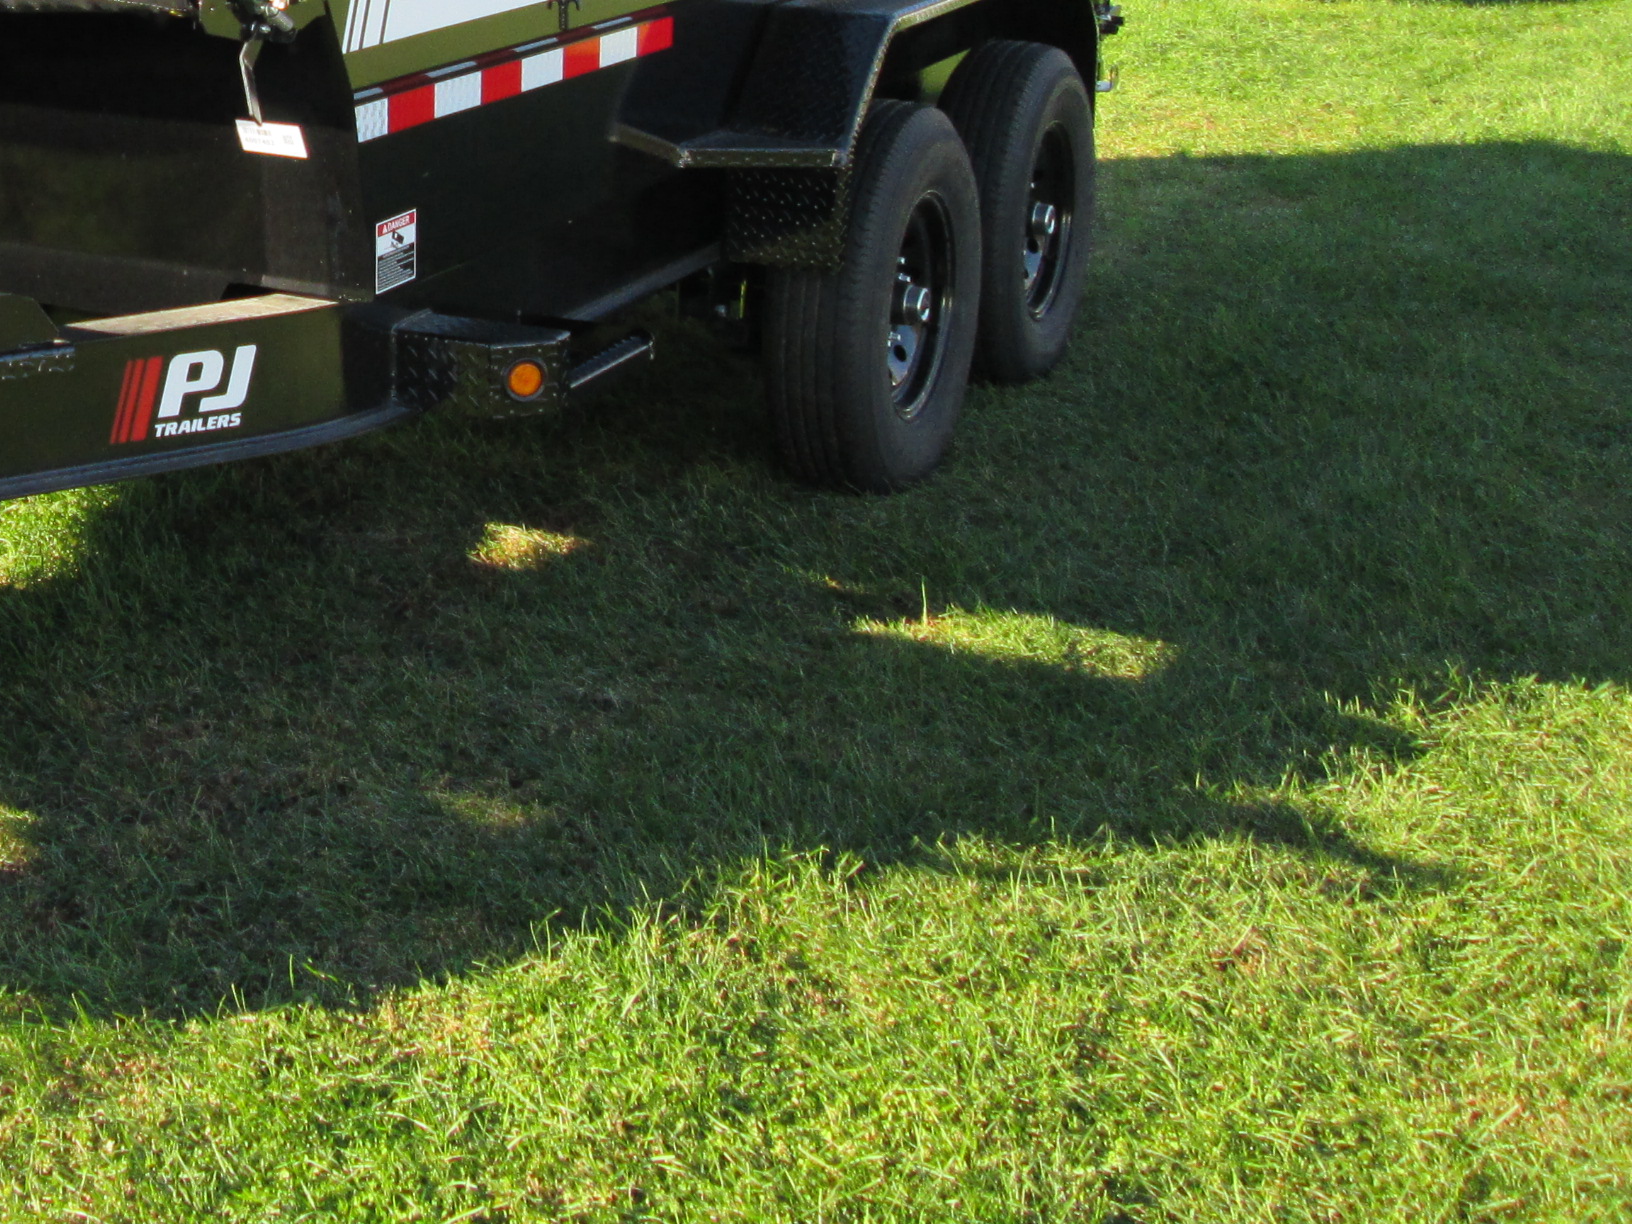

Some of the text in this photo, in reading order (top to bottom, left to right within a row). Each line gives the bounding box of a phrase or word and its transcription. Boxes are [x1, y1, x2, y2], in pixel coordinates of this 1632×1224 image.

[388, 214, 411, 232] DANGER
[157, 344, 258, 419] PJ
[153, 412, 243, 439] TRAILERS
